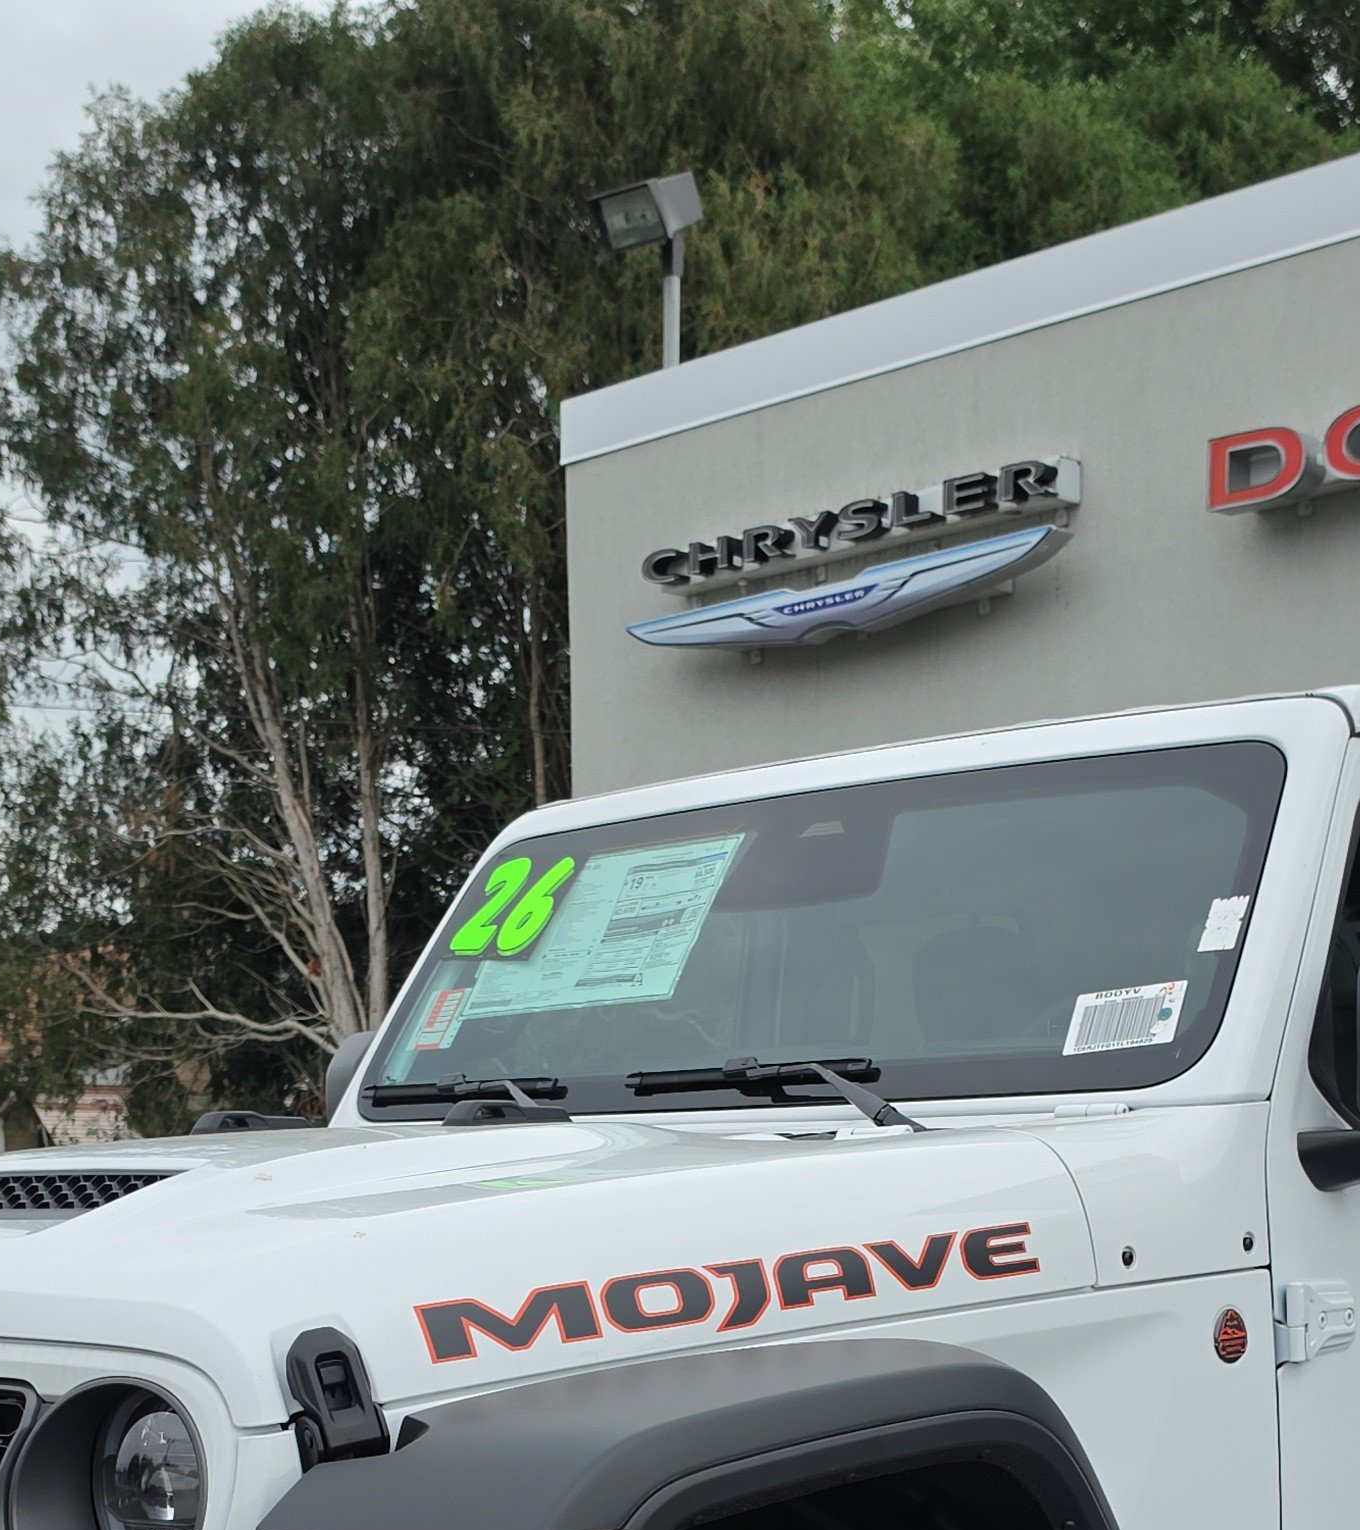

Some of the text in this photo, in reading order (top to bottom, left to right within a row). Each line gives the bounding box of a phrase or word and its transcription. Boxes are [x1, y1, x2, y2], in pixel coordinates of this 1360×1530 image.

[641, 459, 1057, 584] CHRYSLER
[783, 590, 865, 613] CHRYSLER
[449, 856, 576, 956] 26
[413, 1222, 1041, 1364] MOJAVE
